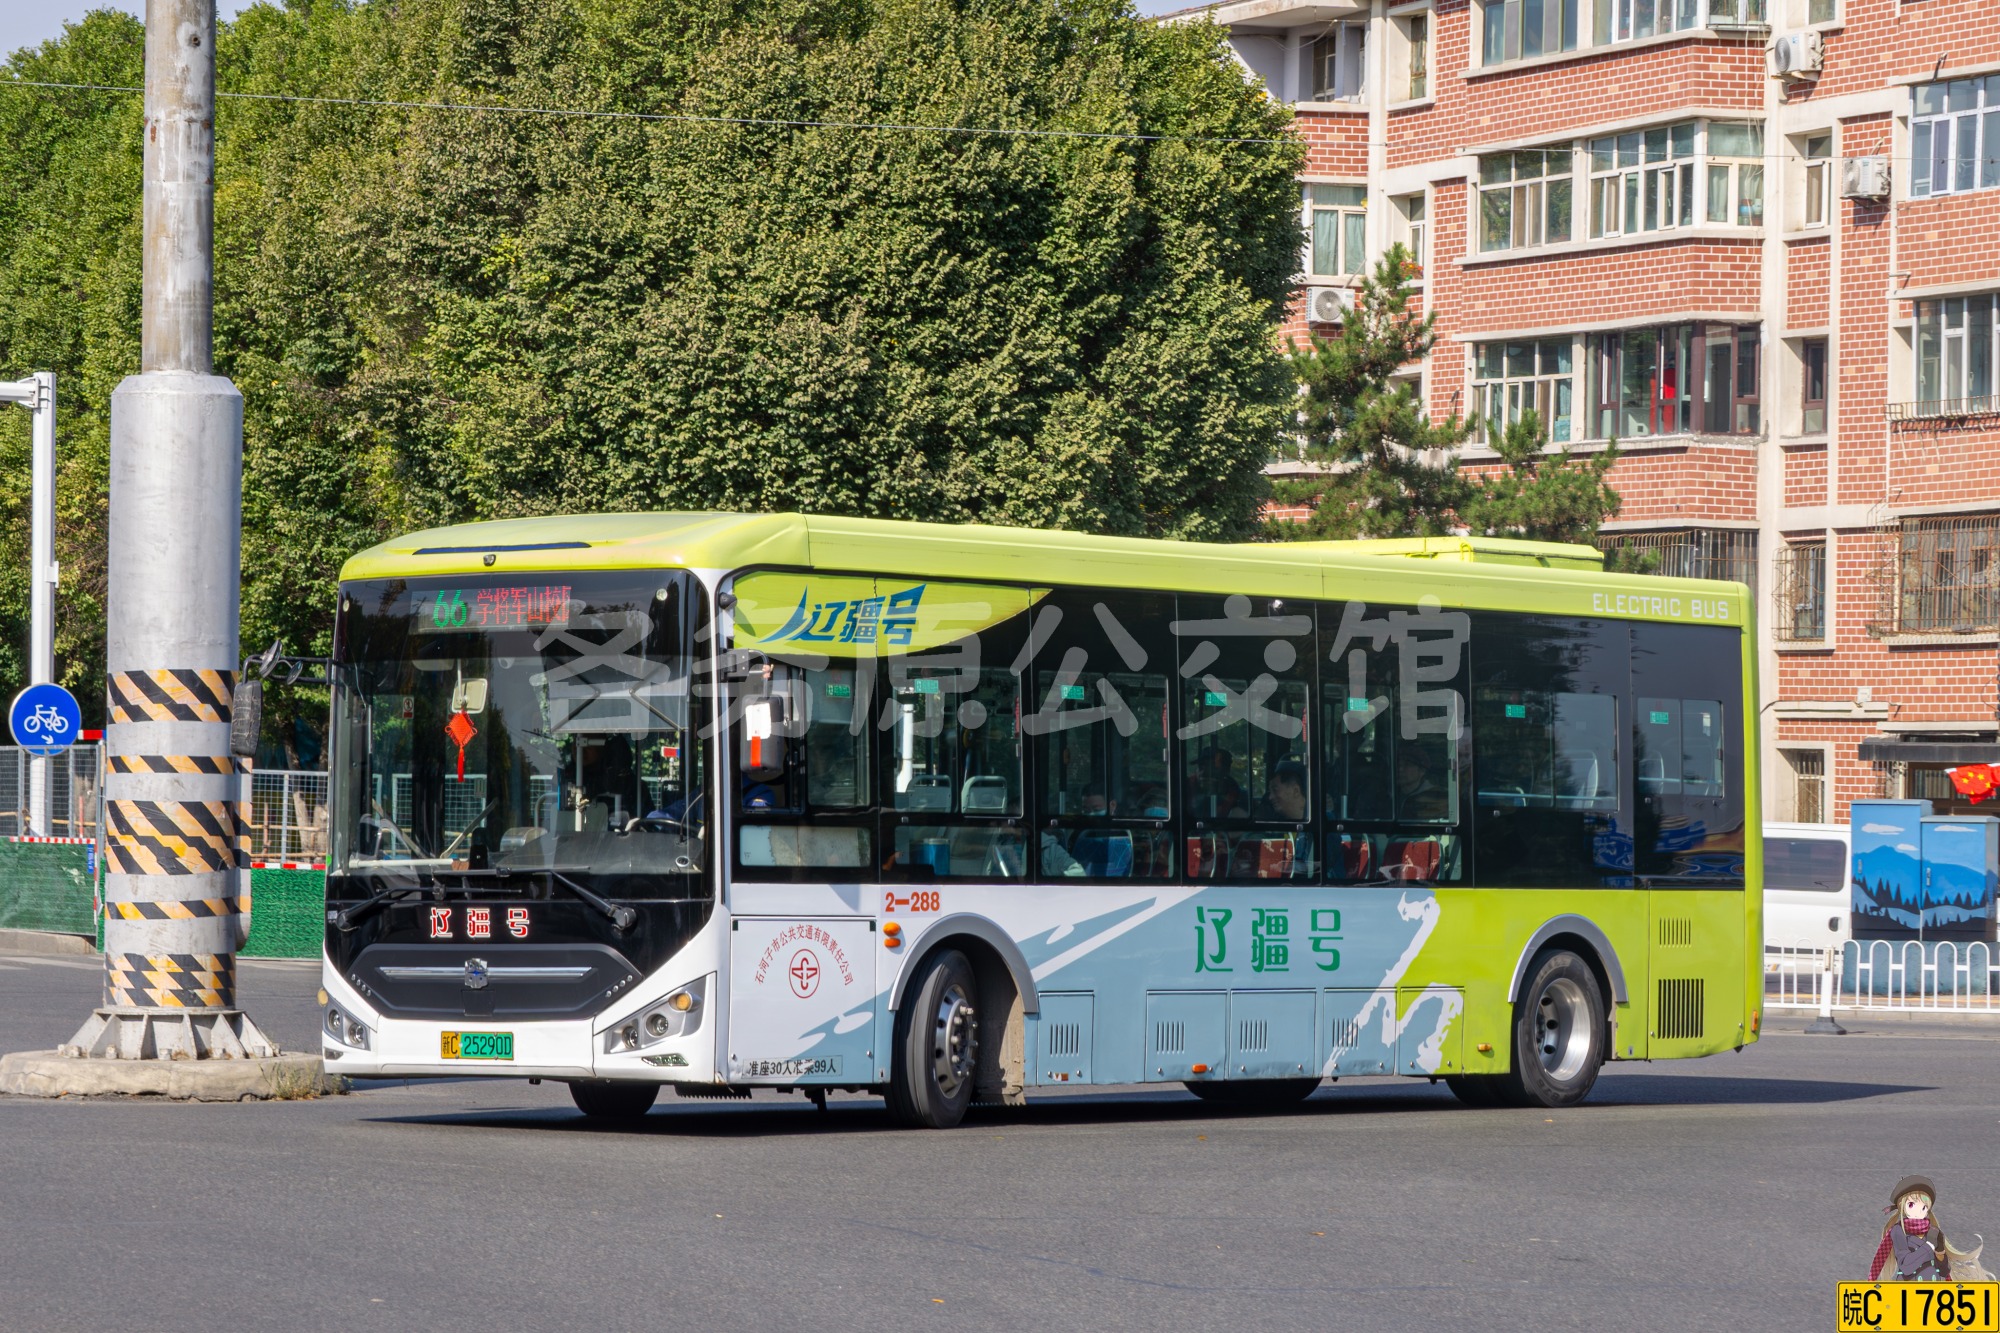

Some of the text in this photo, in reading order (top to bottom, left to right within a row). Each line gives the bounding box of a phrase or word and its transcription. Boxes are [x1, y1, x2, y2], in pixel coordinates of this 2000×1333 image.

[433, 590, 467, 627] 66
[757, 584, 926, 645] 辽疆号
[1593, 593, 1729, 619] ELECTRIC BUS
[430, 907, 530, 938] 辽疆号
[1195, 906, 1343, 973] 辽疆号
[755, 924, 853, 986] 石河子市公共交通有限责任公司
